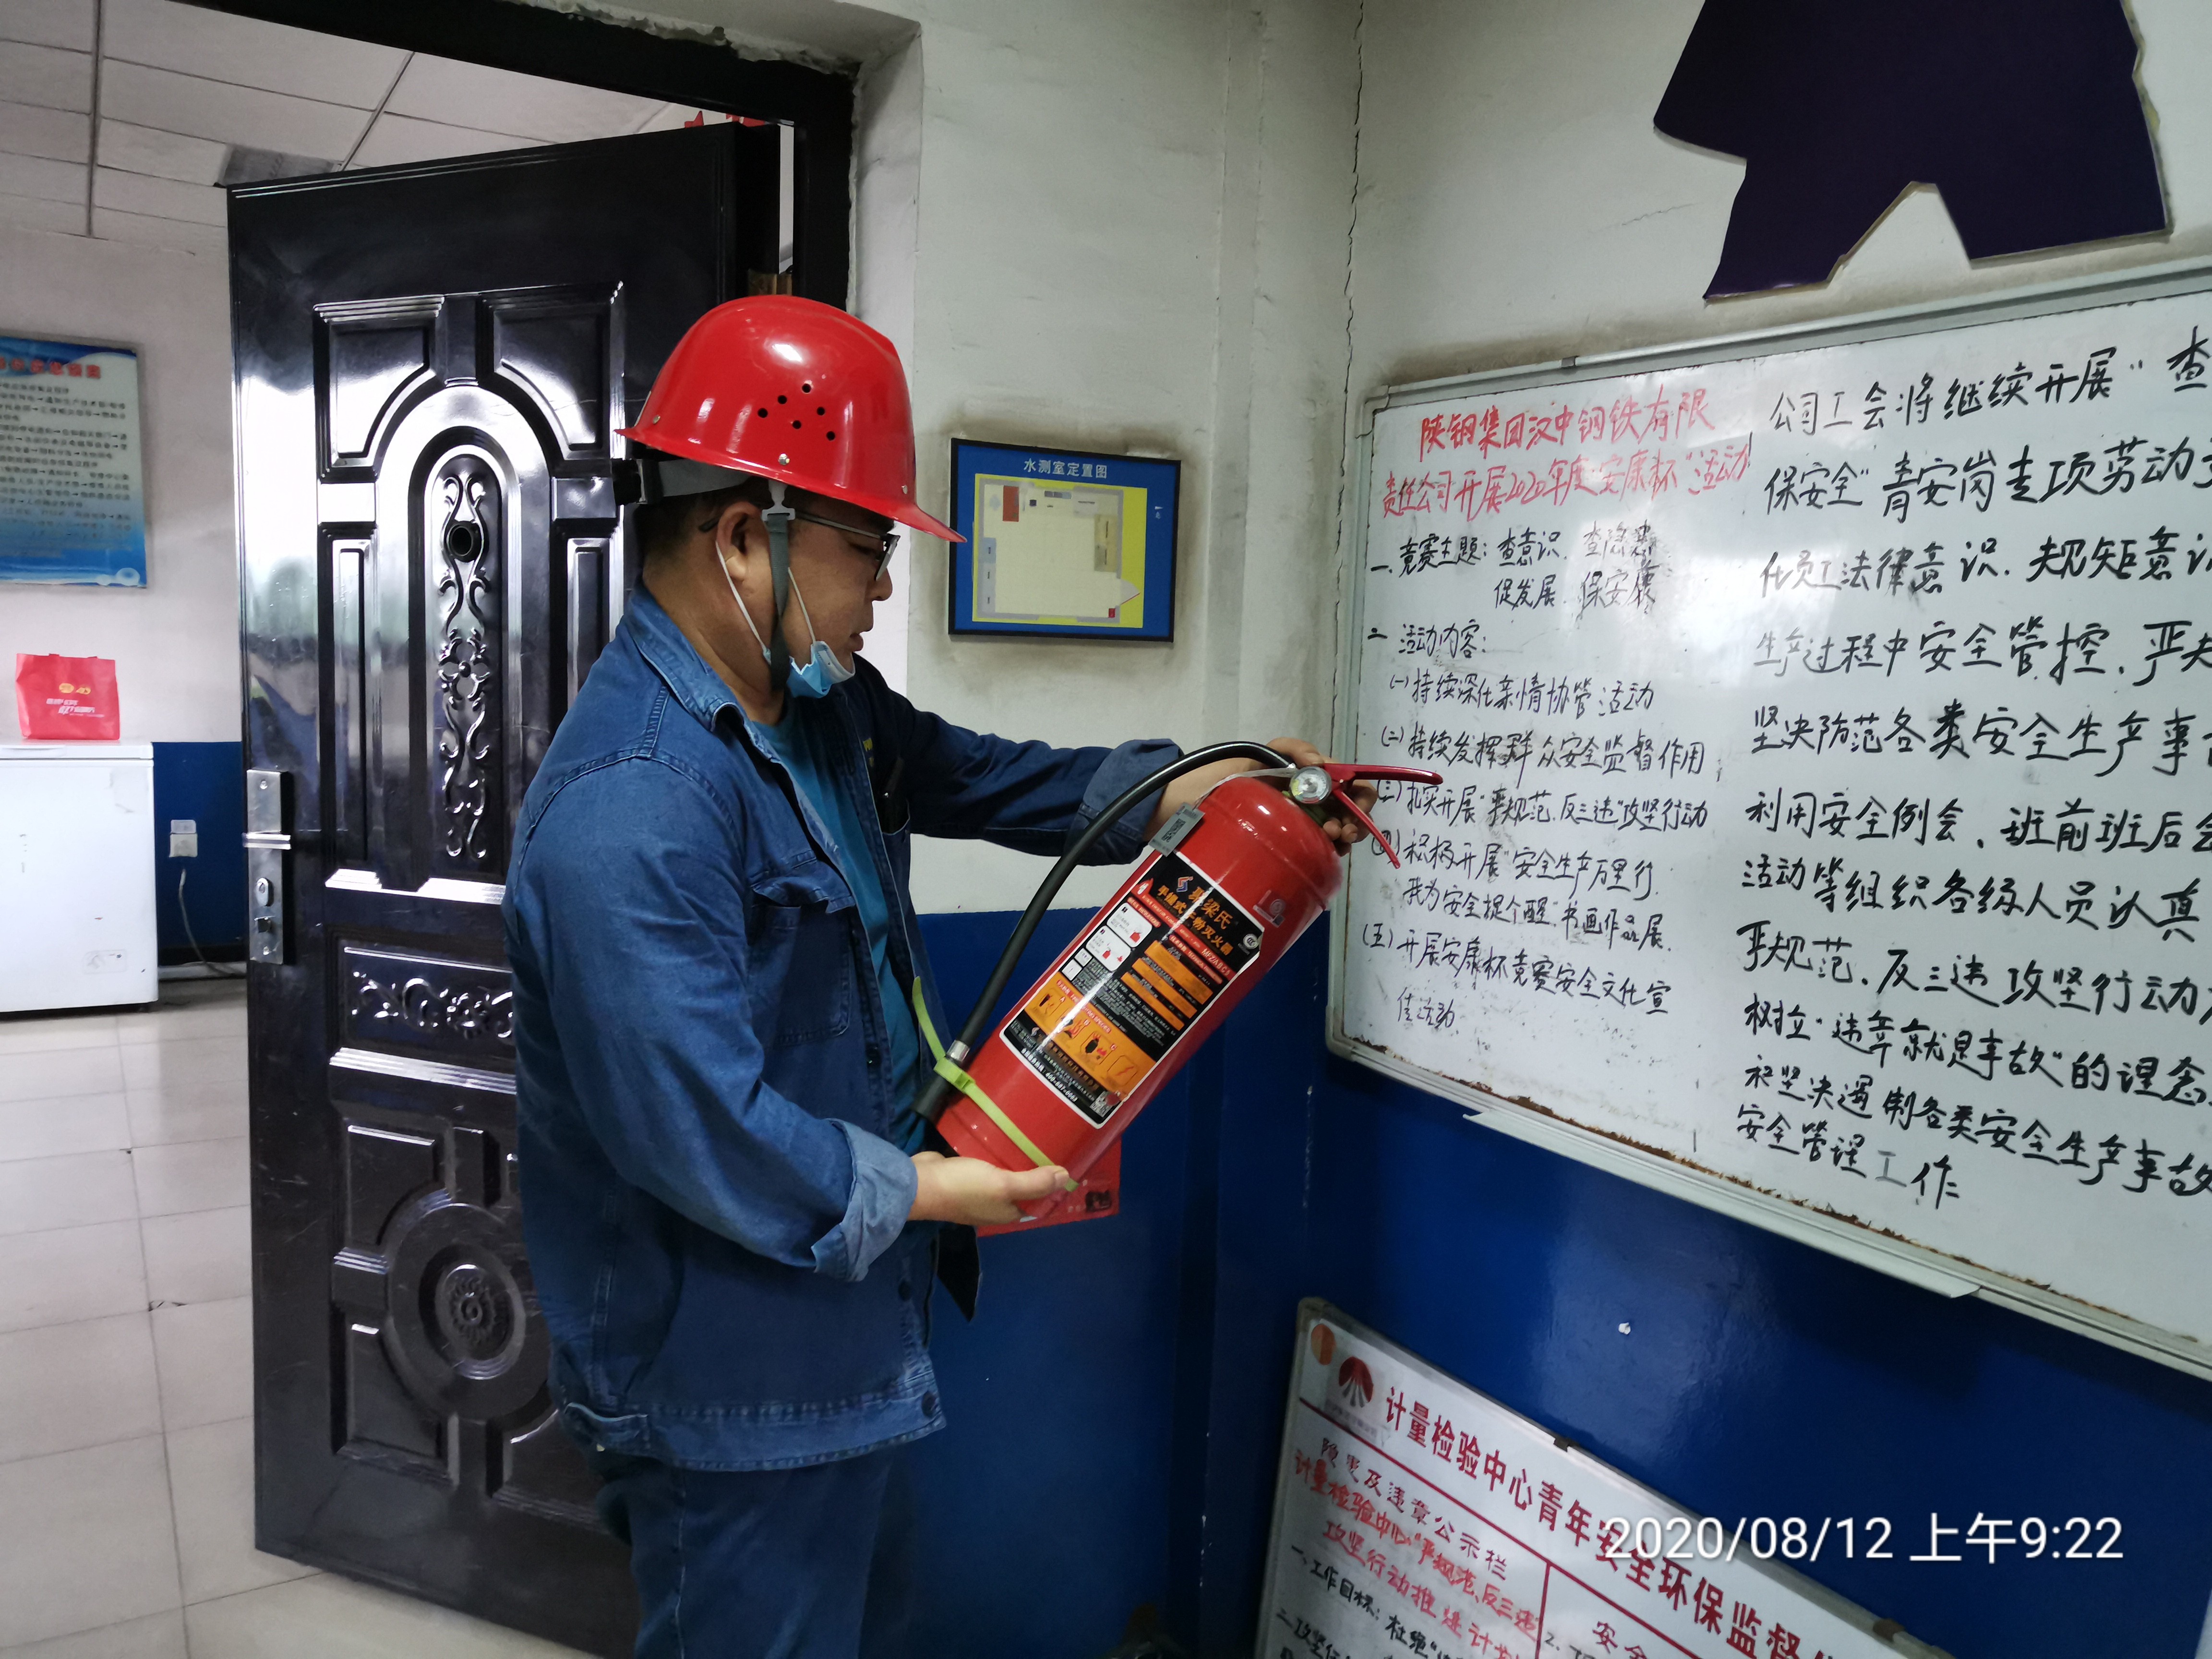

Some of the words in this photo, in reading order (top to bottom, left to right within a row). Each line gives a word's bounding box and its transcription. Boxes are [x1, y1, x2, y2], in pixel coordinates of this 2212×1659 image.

[1419, 384, 1715, 462] 陕钢集团汉中钢铁有限
[1024, 457, 1107, 479] 水测室定置图
[1751, 699, 2212, 777] 坚决防范各类安全生产事
[1741, 853, 2200, 942] 活动等组织各级人员认真
[1736, 1103, 1960, 1210] 安全管理工作
[1384, 1386, 1836, 1659] 计量检验中心青年安全环保监督
